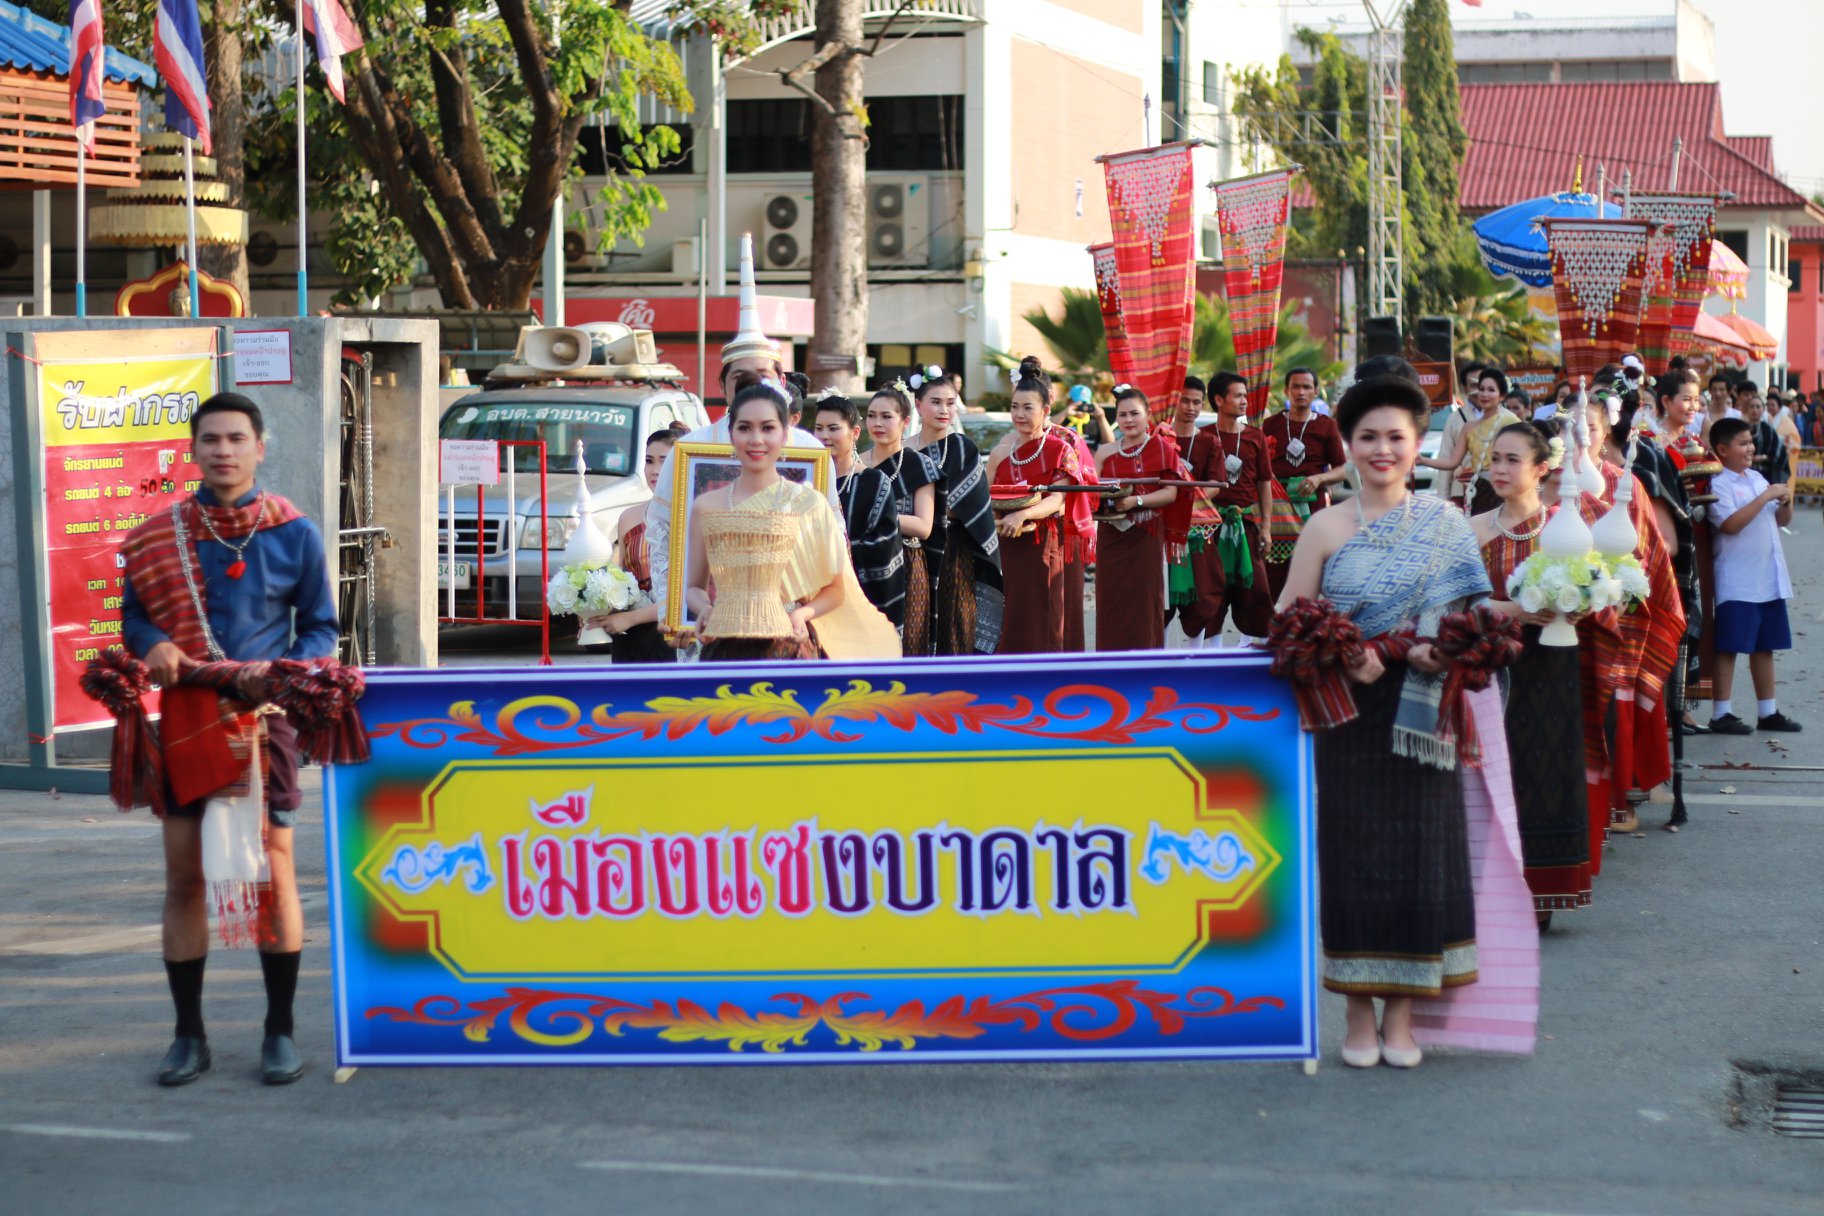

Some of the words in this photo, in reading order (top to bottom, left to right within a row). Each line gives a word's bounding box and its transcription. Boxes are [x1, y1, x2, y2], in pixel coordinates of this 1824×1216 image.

[57, 380, 199, 430] รับฝากรถ
[486, 406, 531, 421] อบต.
[535, 405, 627, 426] สายนาวัง
[64, 451, 124, 471] จักรยานยนต์
[65, 481, 99, 501] รถยนต์
[104, 485, 112, 498] 4
[65, 516, 99, 534] รถยนต์
[104, 519, 111, 531] 6
[88, 579, 107, 591] เวลา
[75, 647, 98, 662] เวลา
[498, 783, 1138, 920] เมืองแซงบาดาล
